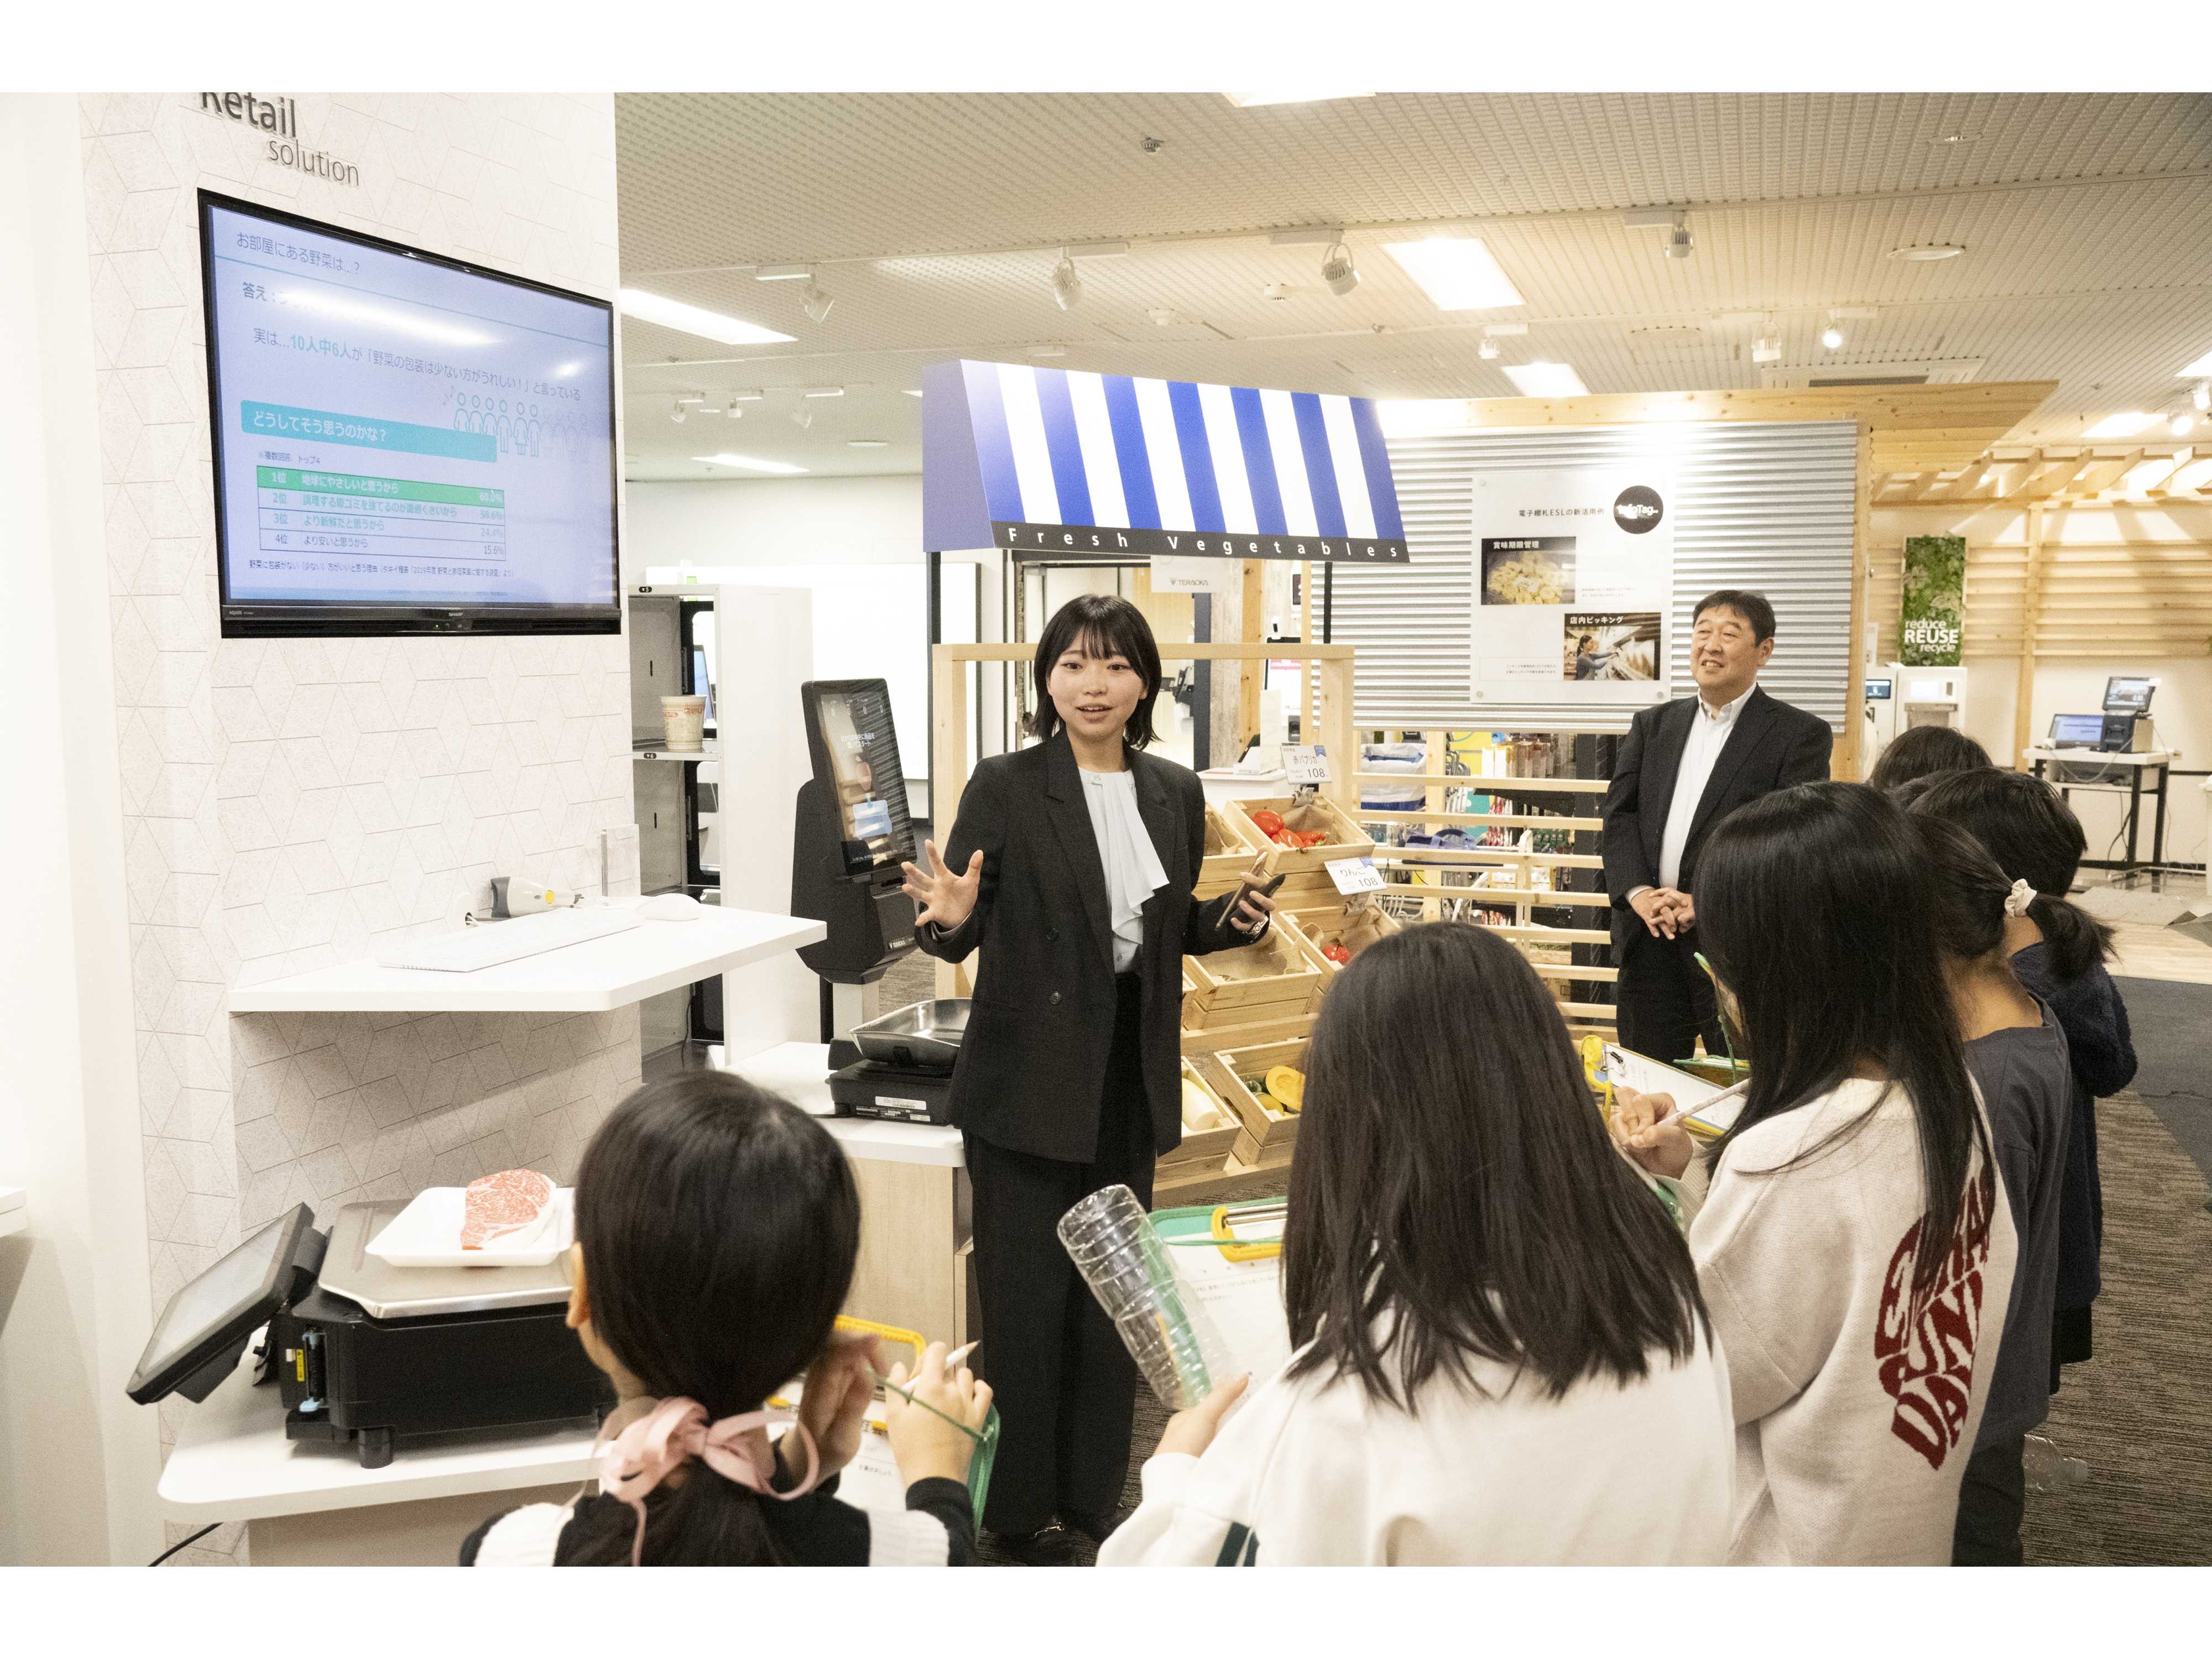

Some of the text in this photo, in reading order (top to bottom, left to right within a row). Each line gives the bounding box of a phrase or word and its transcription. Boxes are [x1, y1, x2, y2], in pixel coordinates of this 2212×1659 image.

[269, 139, 359, 186] solution
[254, 411, 387, 441] どうしてそう思うのかな？
[275, 534, 288, 544] 4位
[305, 536, 368, 548] より安いと思うから
[1008, 528, 1397, 558] Fresh Vegetables
[1493, 540, 1540, 550] 賞味期限管理
[1569, 615, 1624, 624] 店内ピッキング
[1905, 618, 1947, 629] reduce
[1905, 629, 1959, 644] REUSE
[1920, 643, 1956, 654] recycle
[1307, 768, 1326, 778] 108
[1359, 877, 1379, 888] 108
